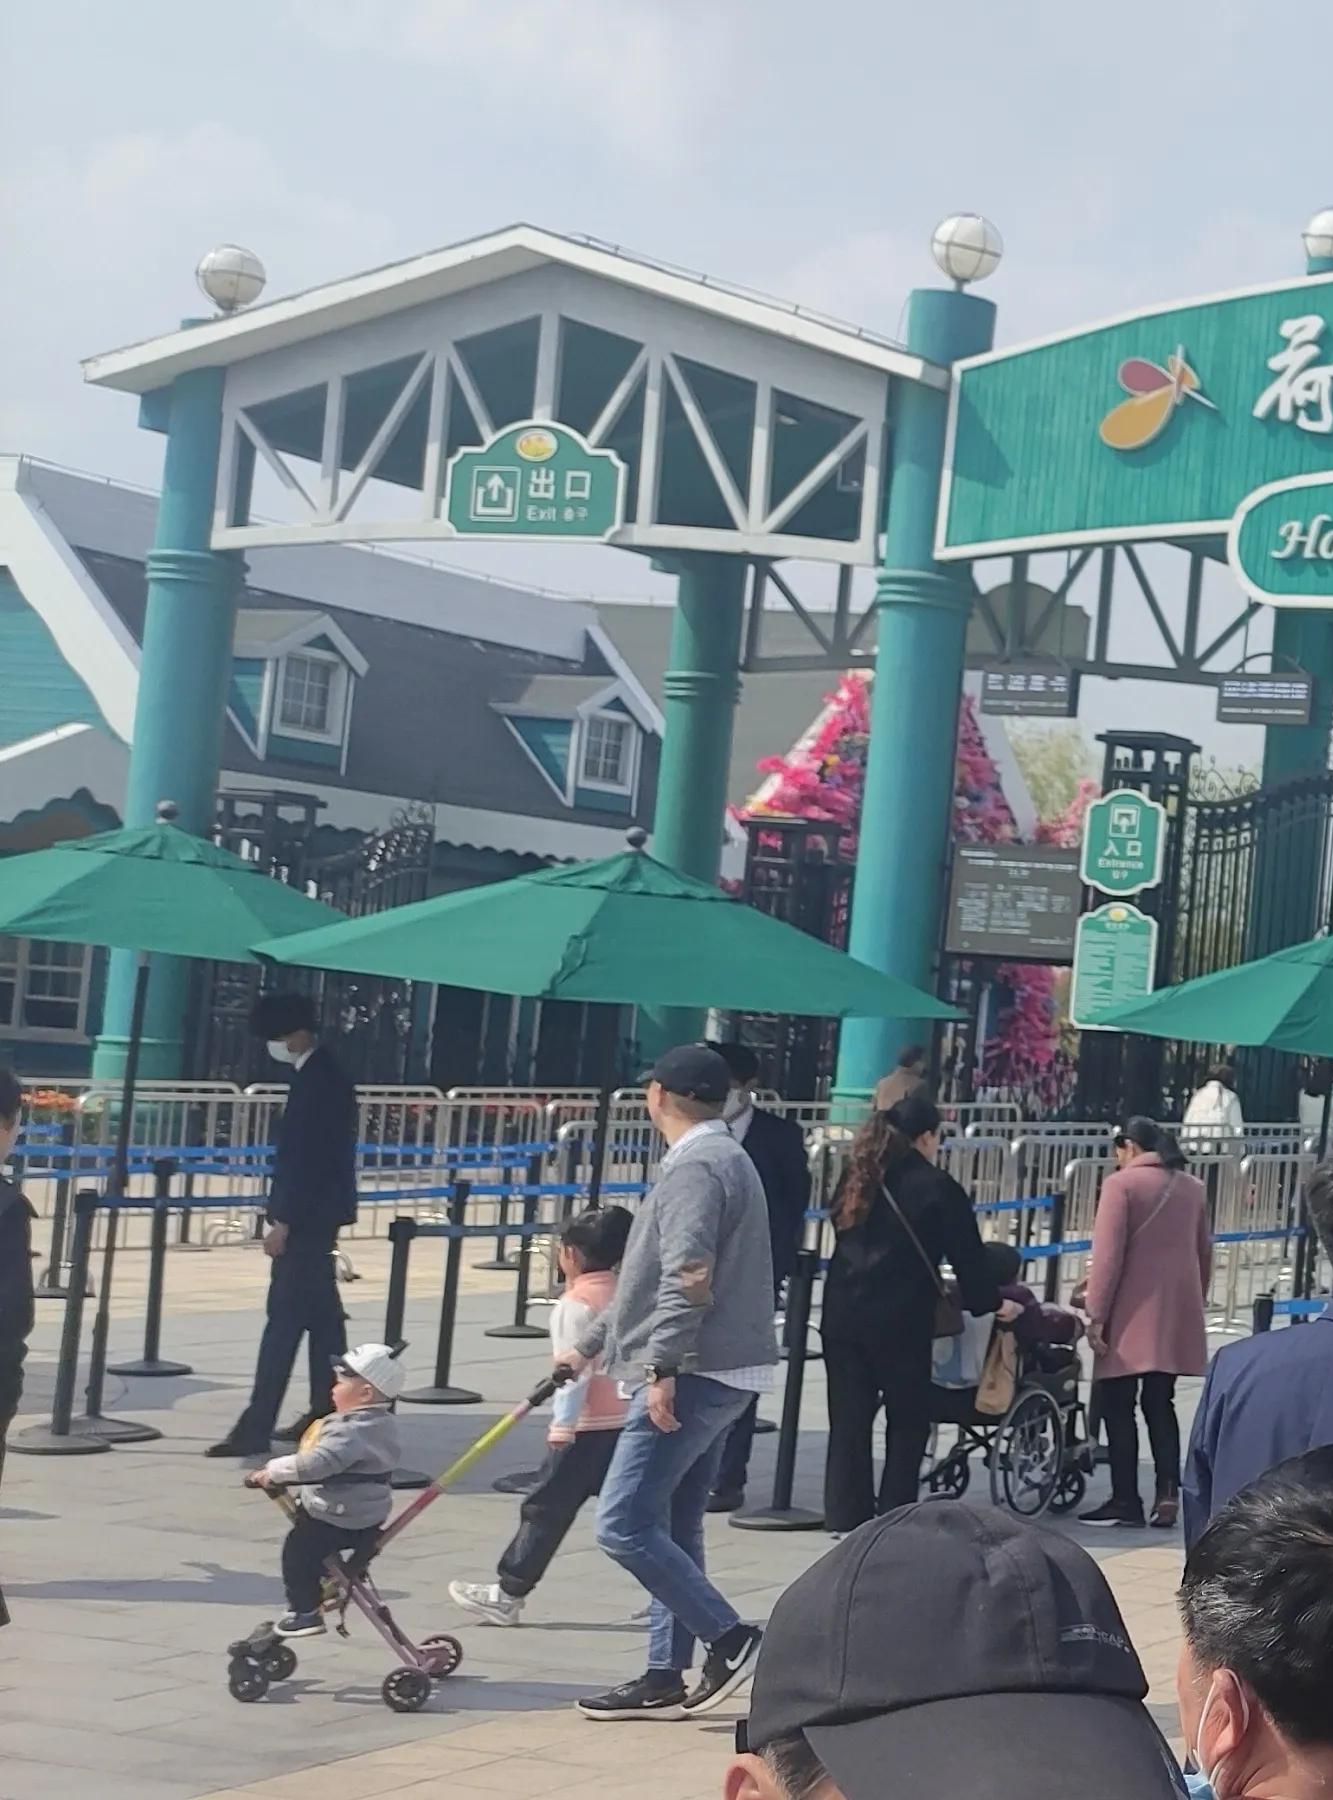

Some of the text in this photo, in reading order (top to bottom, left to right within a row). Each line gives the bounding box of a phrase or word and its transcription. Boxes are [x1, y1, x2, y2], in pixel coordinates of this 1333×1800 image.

[528, 467, 592, 500] 出口
[526, 504, 556, 522] Exit
[1103, 839, 1142, 857] 入口
